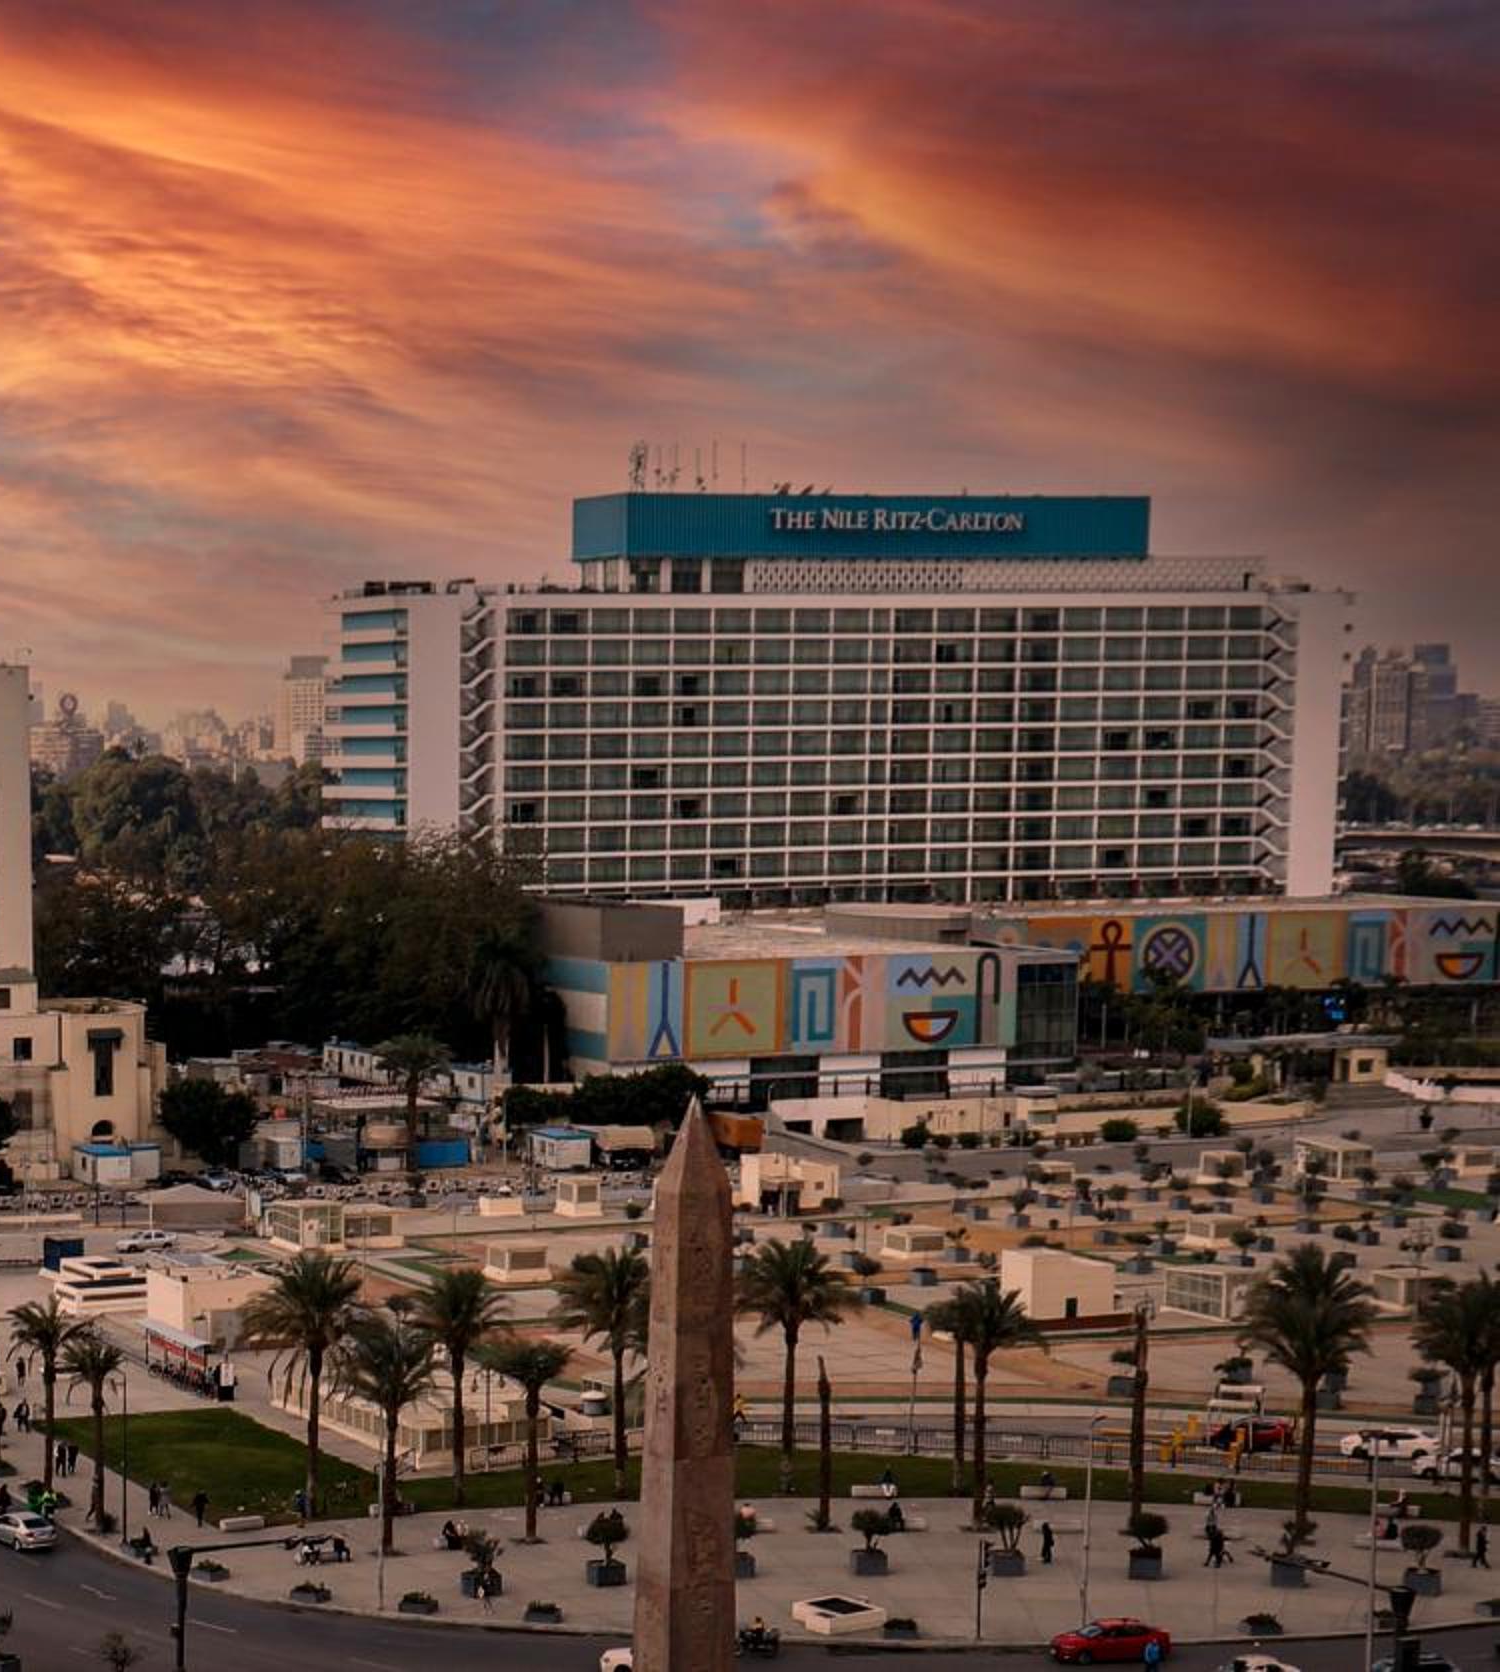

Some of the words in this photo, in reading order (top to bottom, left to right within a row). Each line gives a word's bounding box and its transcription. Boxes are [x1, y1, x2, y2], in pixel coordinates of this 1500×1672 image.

[771, 507, 815, 529] THE
[821, 507, 868, 529] NILE
[873, 508, 1023, 531] RITZ-CARLTON
